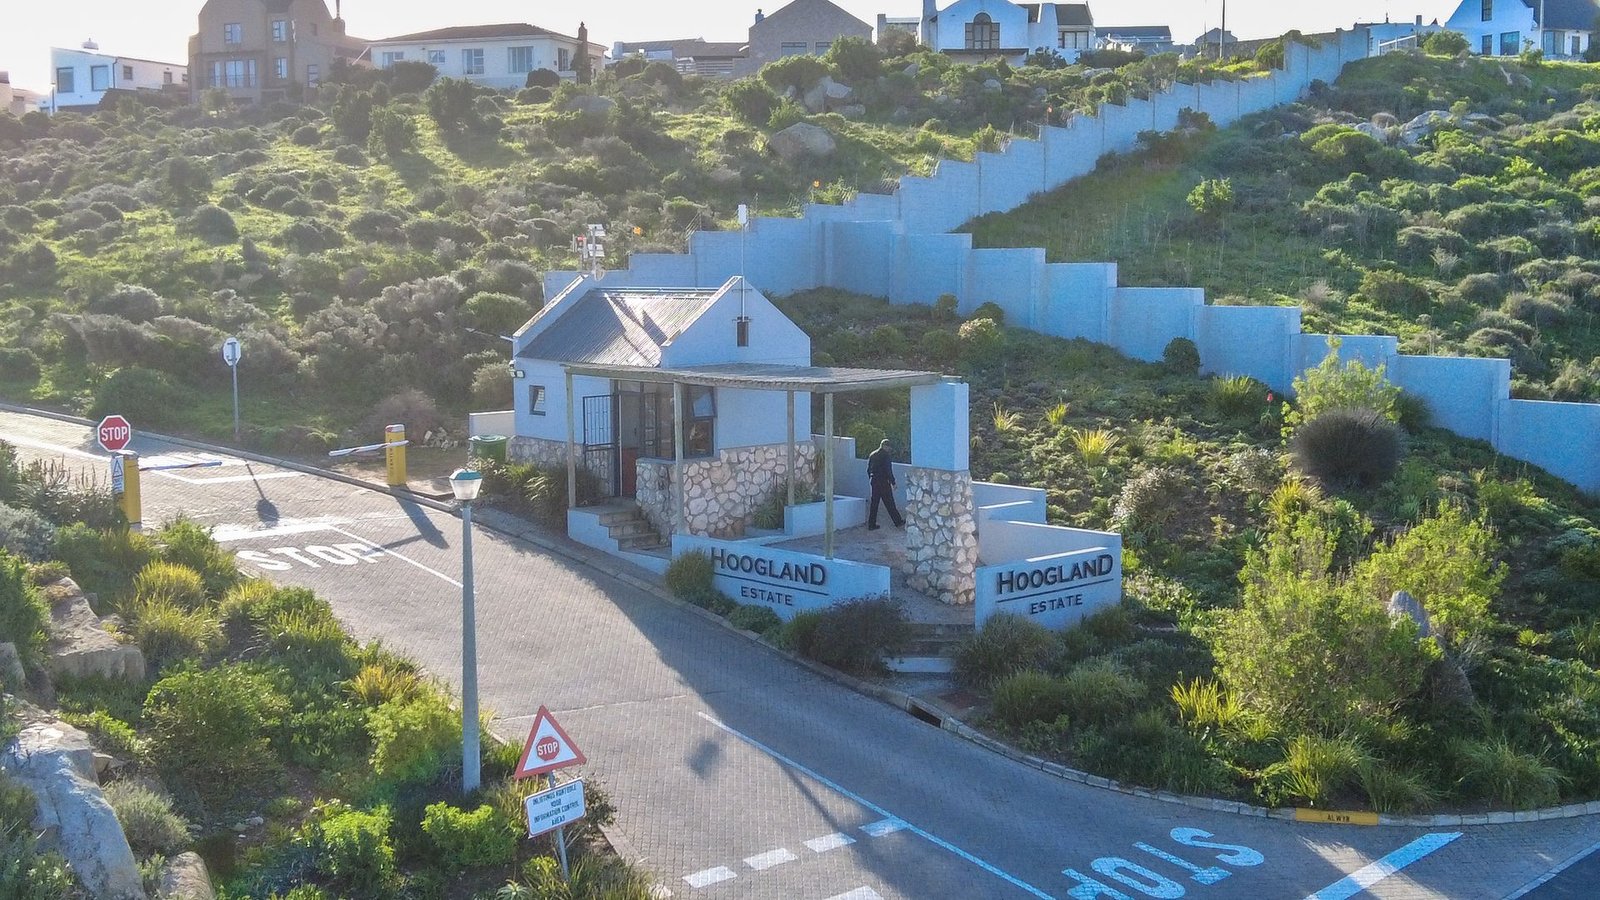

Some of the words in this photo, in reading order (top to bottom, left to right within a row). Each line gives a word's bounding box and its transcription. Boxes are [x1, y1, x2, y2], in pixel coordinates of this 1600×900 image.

[101, 426, 128, 442] STOP
[235, 543, 385, 571] STOP
[711, 547, 827, 586] HOOGLAND
[996, 554, 1113, 595] HOOGLAND
[740, 586, 793, 607] ESTATE
[1030, 594, 1083, 614] ESTATE
[537, 741, 558, 756] STOP
